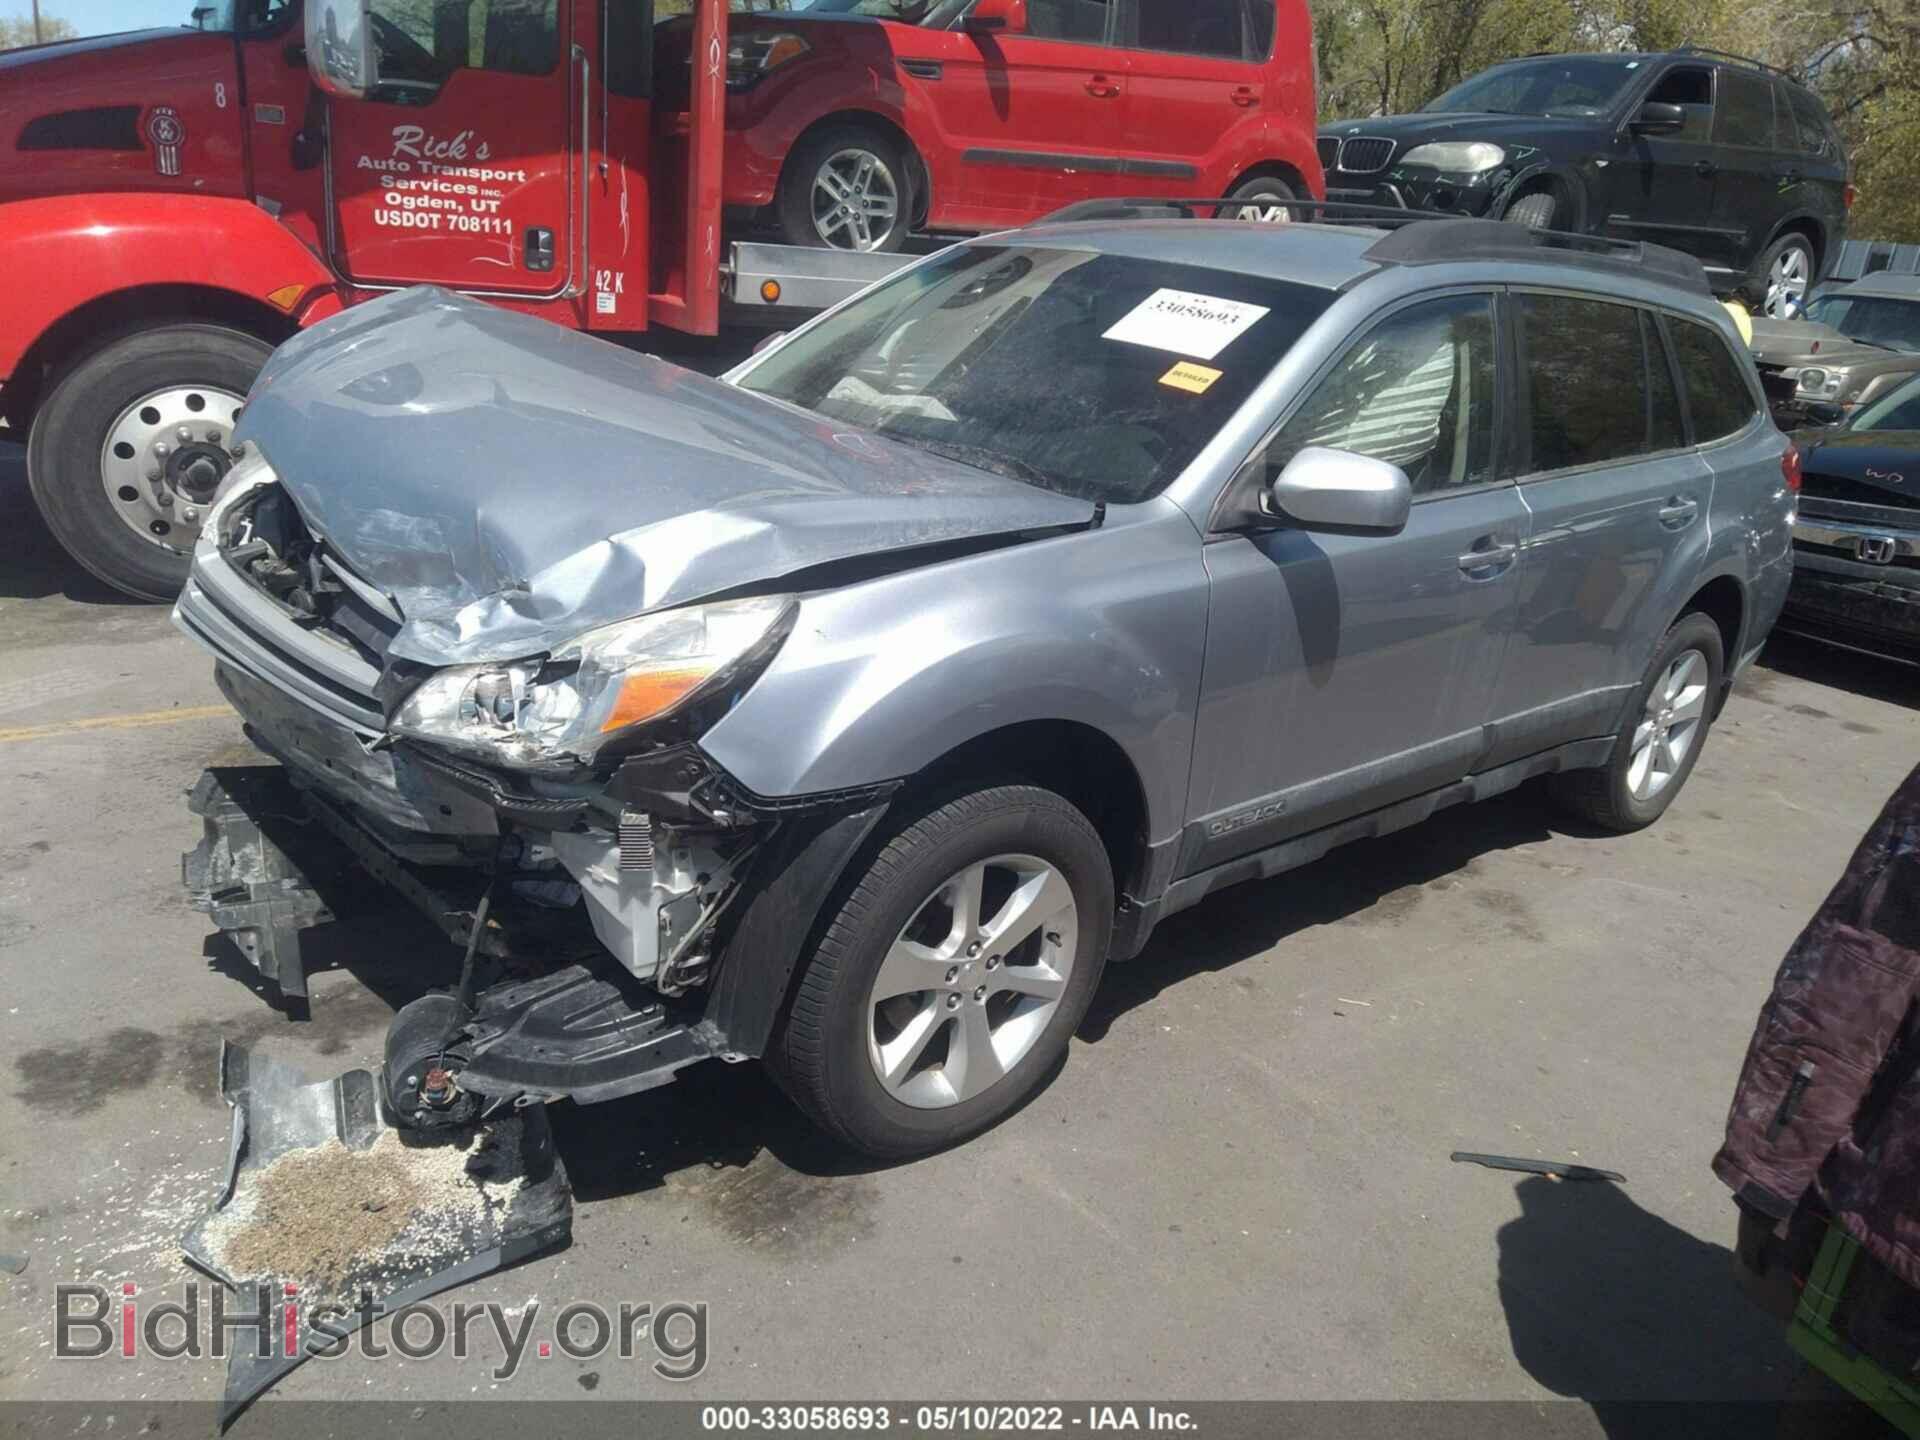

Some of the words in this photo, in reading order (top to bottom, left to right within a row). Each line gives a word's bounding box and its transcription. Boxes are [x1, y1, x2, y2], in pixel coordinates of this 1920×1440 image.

[215, 82, 226, 108] 8
[392, 125, 490, 160] Rick's
[357, 155, 410, 172] Auto
[417, 160, 526, 182] Transport
[380, 175, 478, 195] Services
[480, 189, 504, 197] INC.
[384, 192, 464, 212] Ogden,
[471, 199, 500, 213] UT
[374, 209, 441, 229] USDOT
[447, 214, 512, 235] 708111
[596, 270, 611, 291] 42
[615, 272, 624, 293] K
[1150, 300, 1240, 325] 33058693
